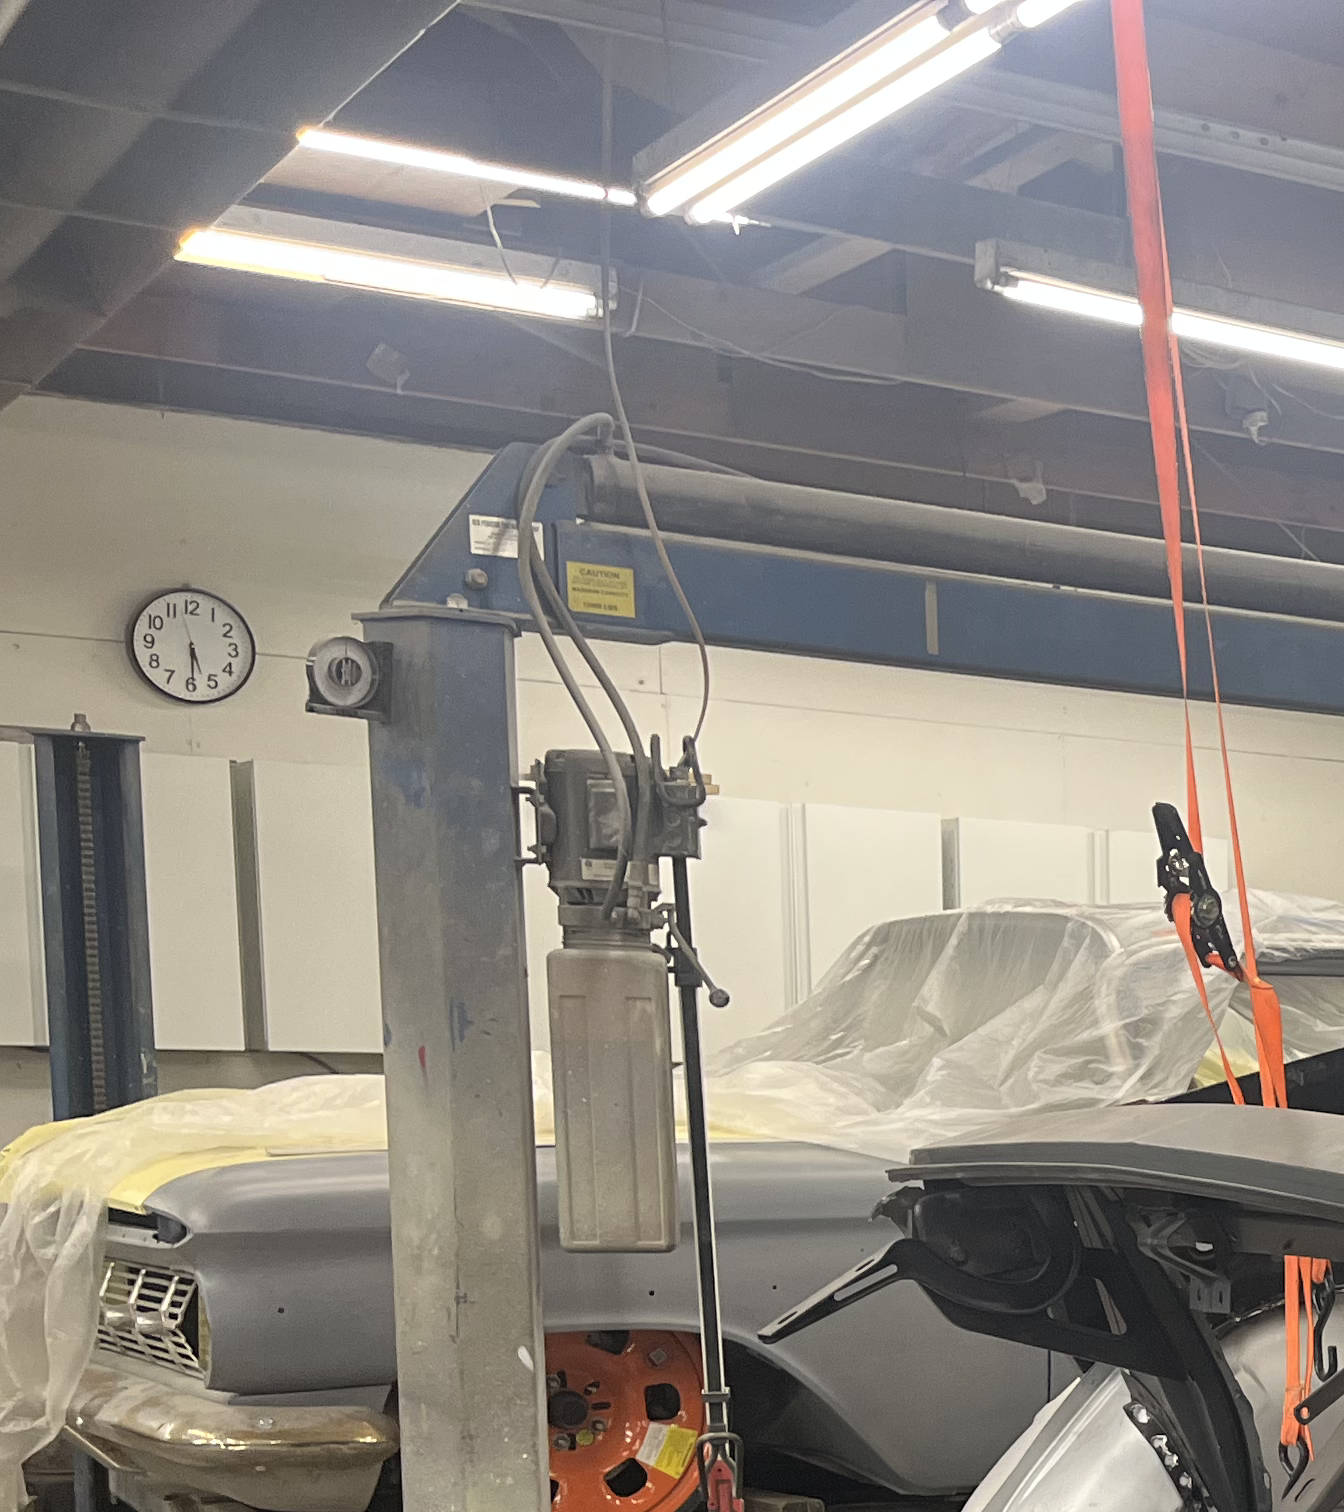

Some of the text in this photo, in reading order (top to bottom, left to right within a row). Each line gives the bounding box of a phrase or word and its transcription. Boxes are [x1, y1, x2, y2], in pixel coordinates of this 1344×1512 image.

[580, 567, 620, 580] CAUTION
[166, 602, 177, 619] 11
[184, 599, 200, 616] 12
[148, 613, 164, 630] 10
[222, 622, 233, 639] 2
[143, 633, 155, 649] 9
[227, 642, 239, 658] 3
[149, 653, 160, 669] 8
[222, 661, 234, 677] 4
[164, 668, 175, 685] 7
[185, 676, 197, 692] 6
[207, 673, 218, 689] 5
